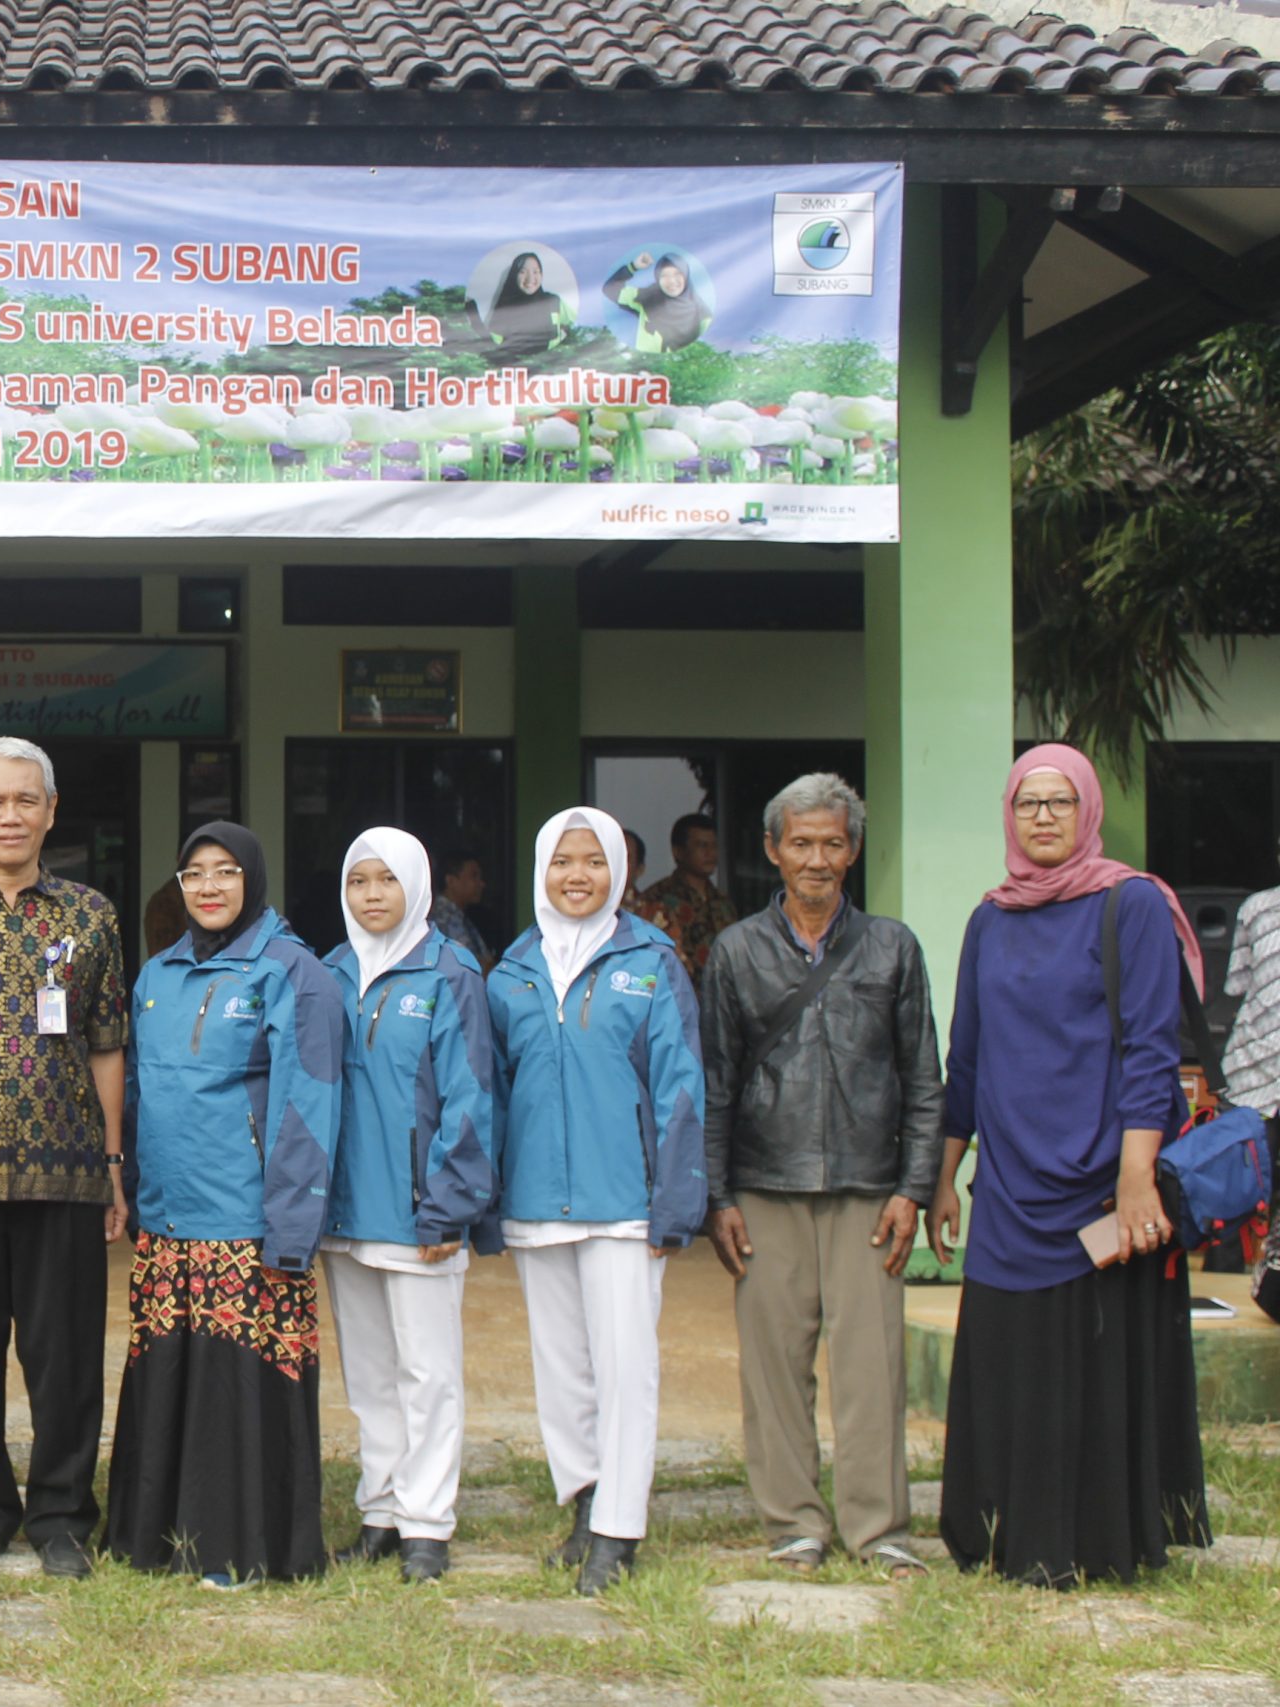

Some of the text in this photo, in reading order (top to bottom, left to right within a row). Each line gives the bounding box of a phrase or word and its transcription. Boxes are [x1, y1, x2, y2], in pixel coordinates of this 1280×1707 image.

[800, 198, 849, 210] SMKN 2
[136, 245, 159, 280] 2
[174, 244, 358, 283] SUBANG
[797, 279, 848, 290] SUBANG
[38, 306, 252, 352] university
[268, 307, 439, 345] Belanda
[141, 368, 300, 413] Pangan
[314, 369, 392, 406] dan
[408, 370, 669, 407] Hortikultura
[16, 430, 126, 466] 2019
[675, 509, 730, 523] neso
[17, 673, 25, 687] 2
[33, 673, 115, 687] SUBANG
[114, 697, 152, 735] for
[162, 695, 202, 723] all
